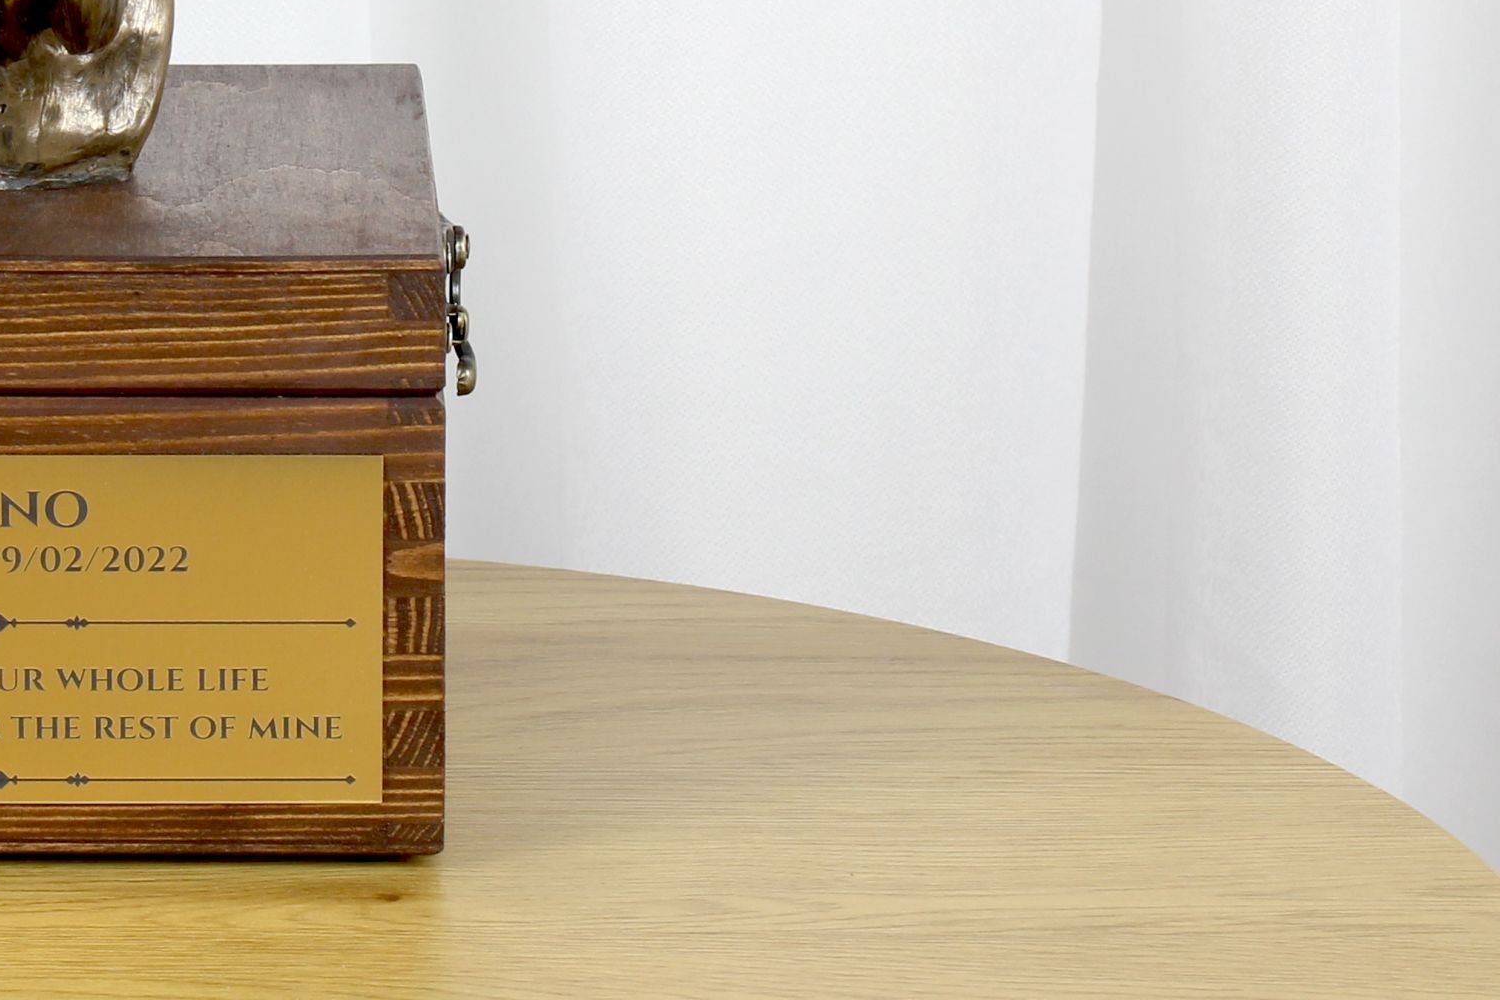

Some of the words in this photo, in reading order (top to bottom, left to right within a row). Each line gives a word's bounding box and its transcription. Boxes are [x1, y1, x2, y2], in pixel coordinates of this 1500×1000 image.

[1, 545, 190, 575] 9/02/2022
[56, 667, 185, 692] WHOLE
[196, 667, 270, 692] LIFE
[10, 715, 82, 740] THE
[93, 715, 176, 740] REST
[188, 715, 237, 740] OF
[248, 715, 343, 740] MINE
